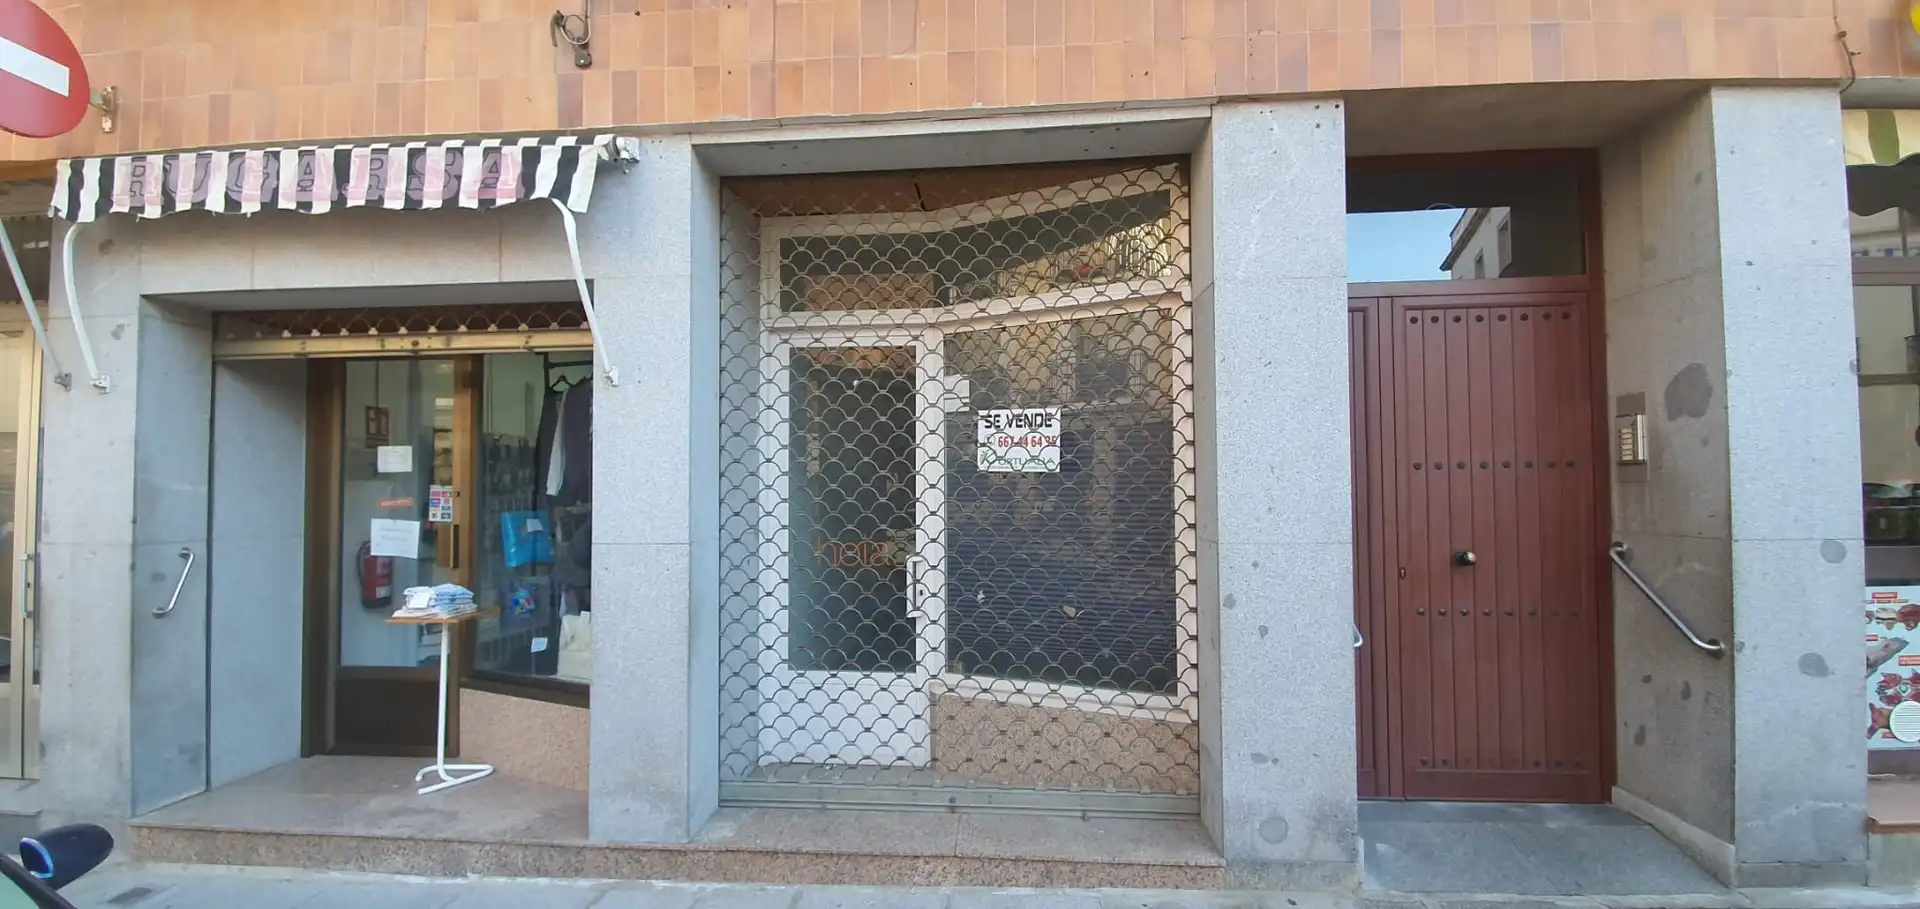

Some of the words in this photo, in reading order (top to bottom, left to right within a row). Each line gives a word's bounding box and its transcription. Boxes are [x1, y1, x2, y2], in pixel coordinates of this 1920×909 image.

[112, 150, 525, 207] RUGARSA
[984, 414, 1001, 428] SE
[1006, 413, 1053, 428] VENDE
[1031, 436, 1042, 447] 64
